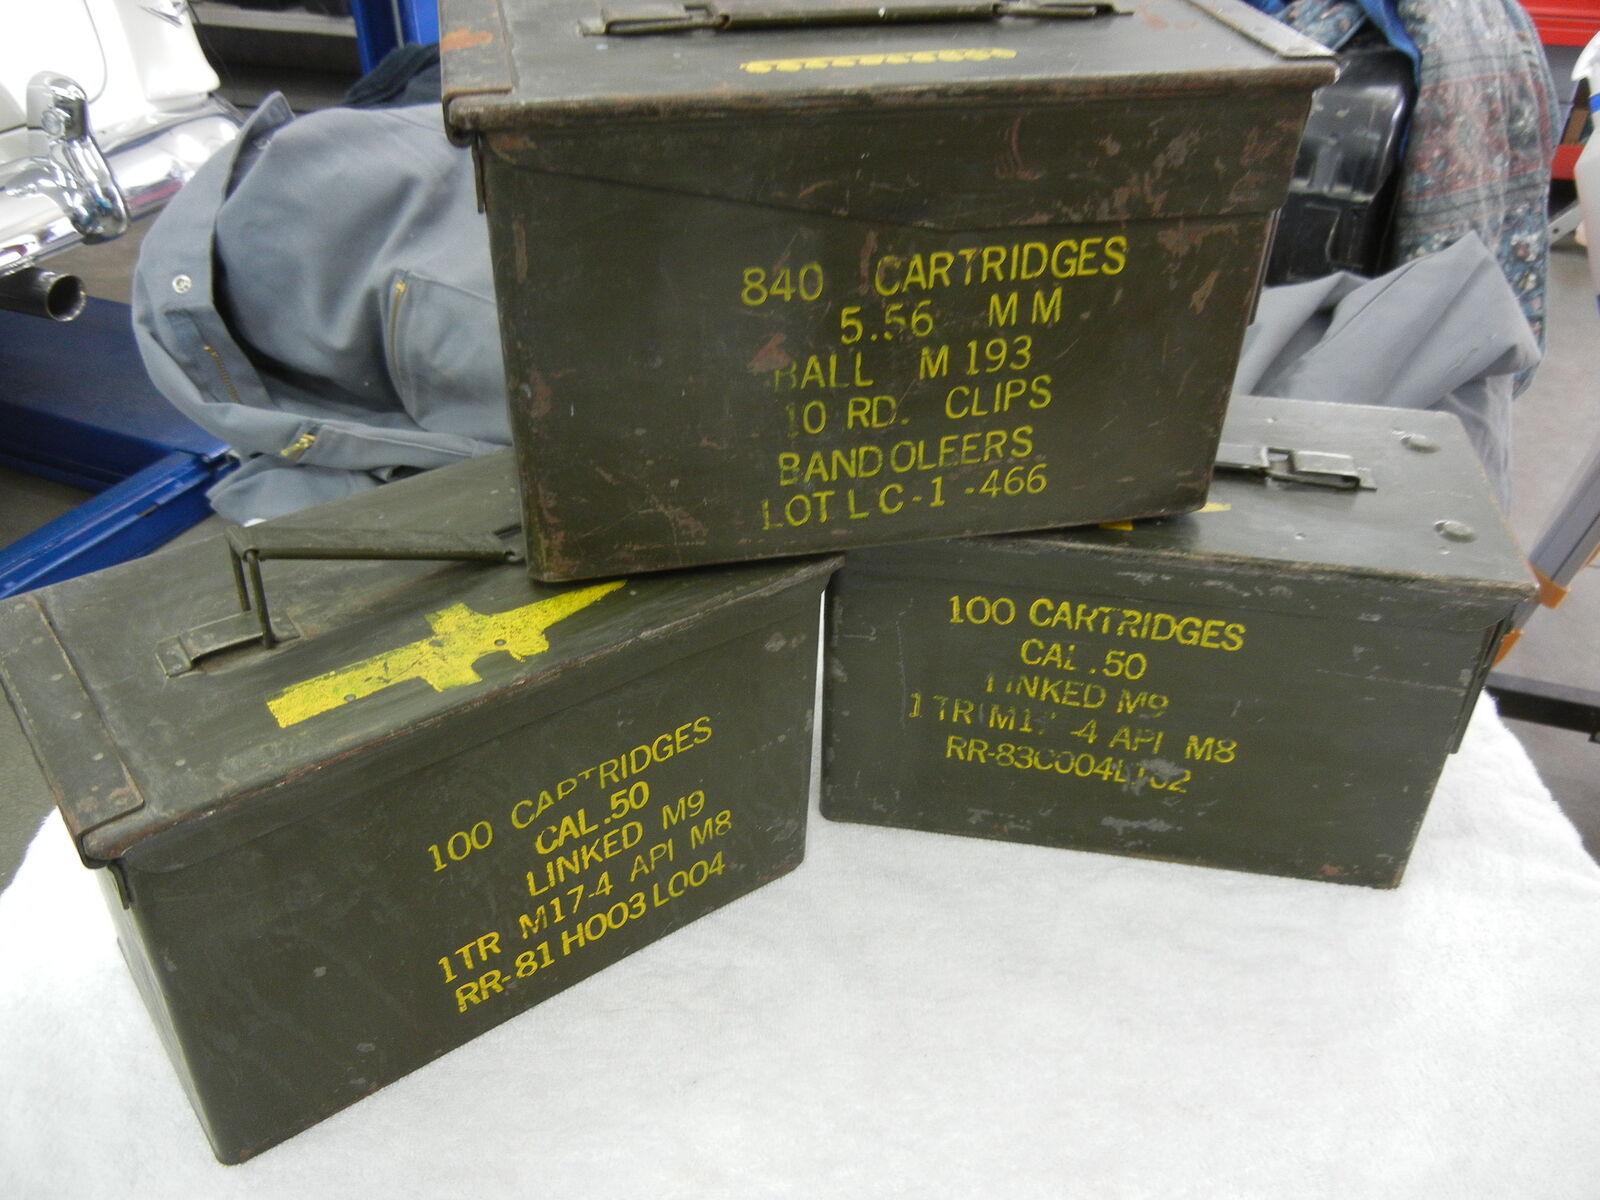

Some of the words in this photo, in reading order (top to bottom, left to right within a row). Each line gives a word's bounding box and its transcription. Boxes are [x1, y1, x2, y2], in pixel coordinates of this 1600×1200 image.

[741, 262, 823, 306] 840
[875, 235, 1127, 297] CARTRIDGES
[840, 300, 934, 344] 5.56
[786, 401, 826, 437] 10
[847, 396, 908, 430] RD.
[945, 375, 1053, 419] CLIPS
[779, 426, 1033, 485] BANDOLEERS
[762, 490, 834, 530] LOT
[949, 595, 1016, 625] 100
[1030, 598, 1246, 651] CARTRIDGES
[1021, 638, 1077, 671] CAL
[1090, 651, 1146, 680] .50
[908, 693, 921, 718] 1
[933, 695, 974, 724] TR
[1109, 727, 1163, 755] API
[1185, 735, 1237, 762] M8
[428, 821, 493, 872] 100
[526, 821, 644, 896] LINKED
[662, 790, 705, 830] M9
[630, 839, 674, 882] API
[691, 810, 732, 848] M8
